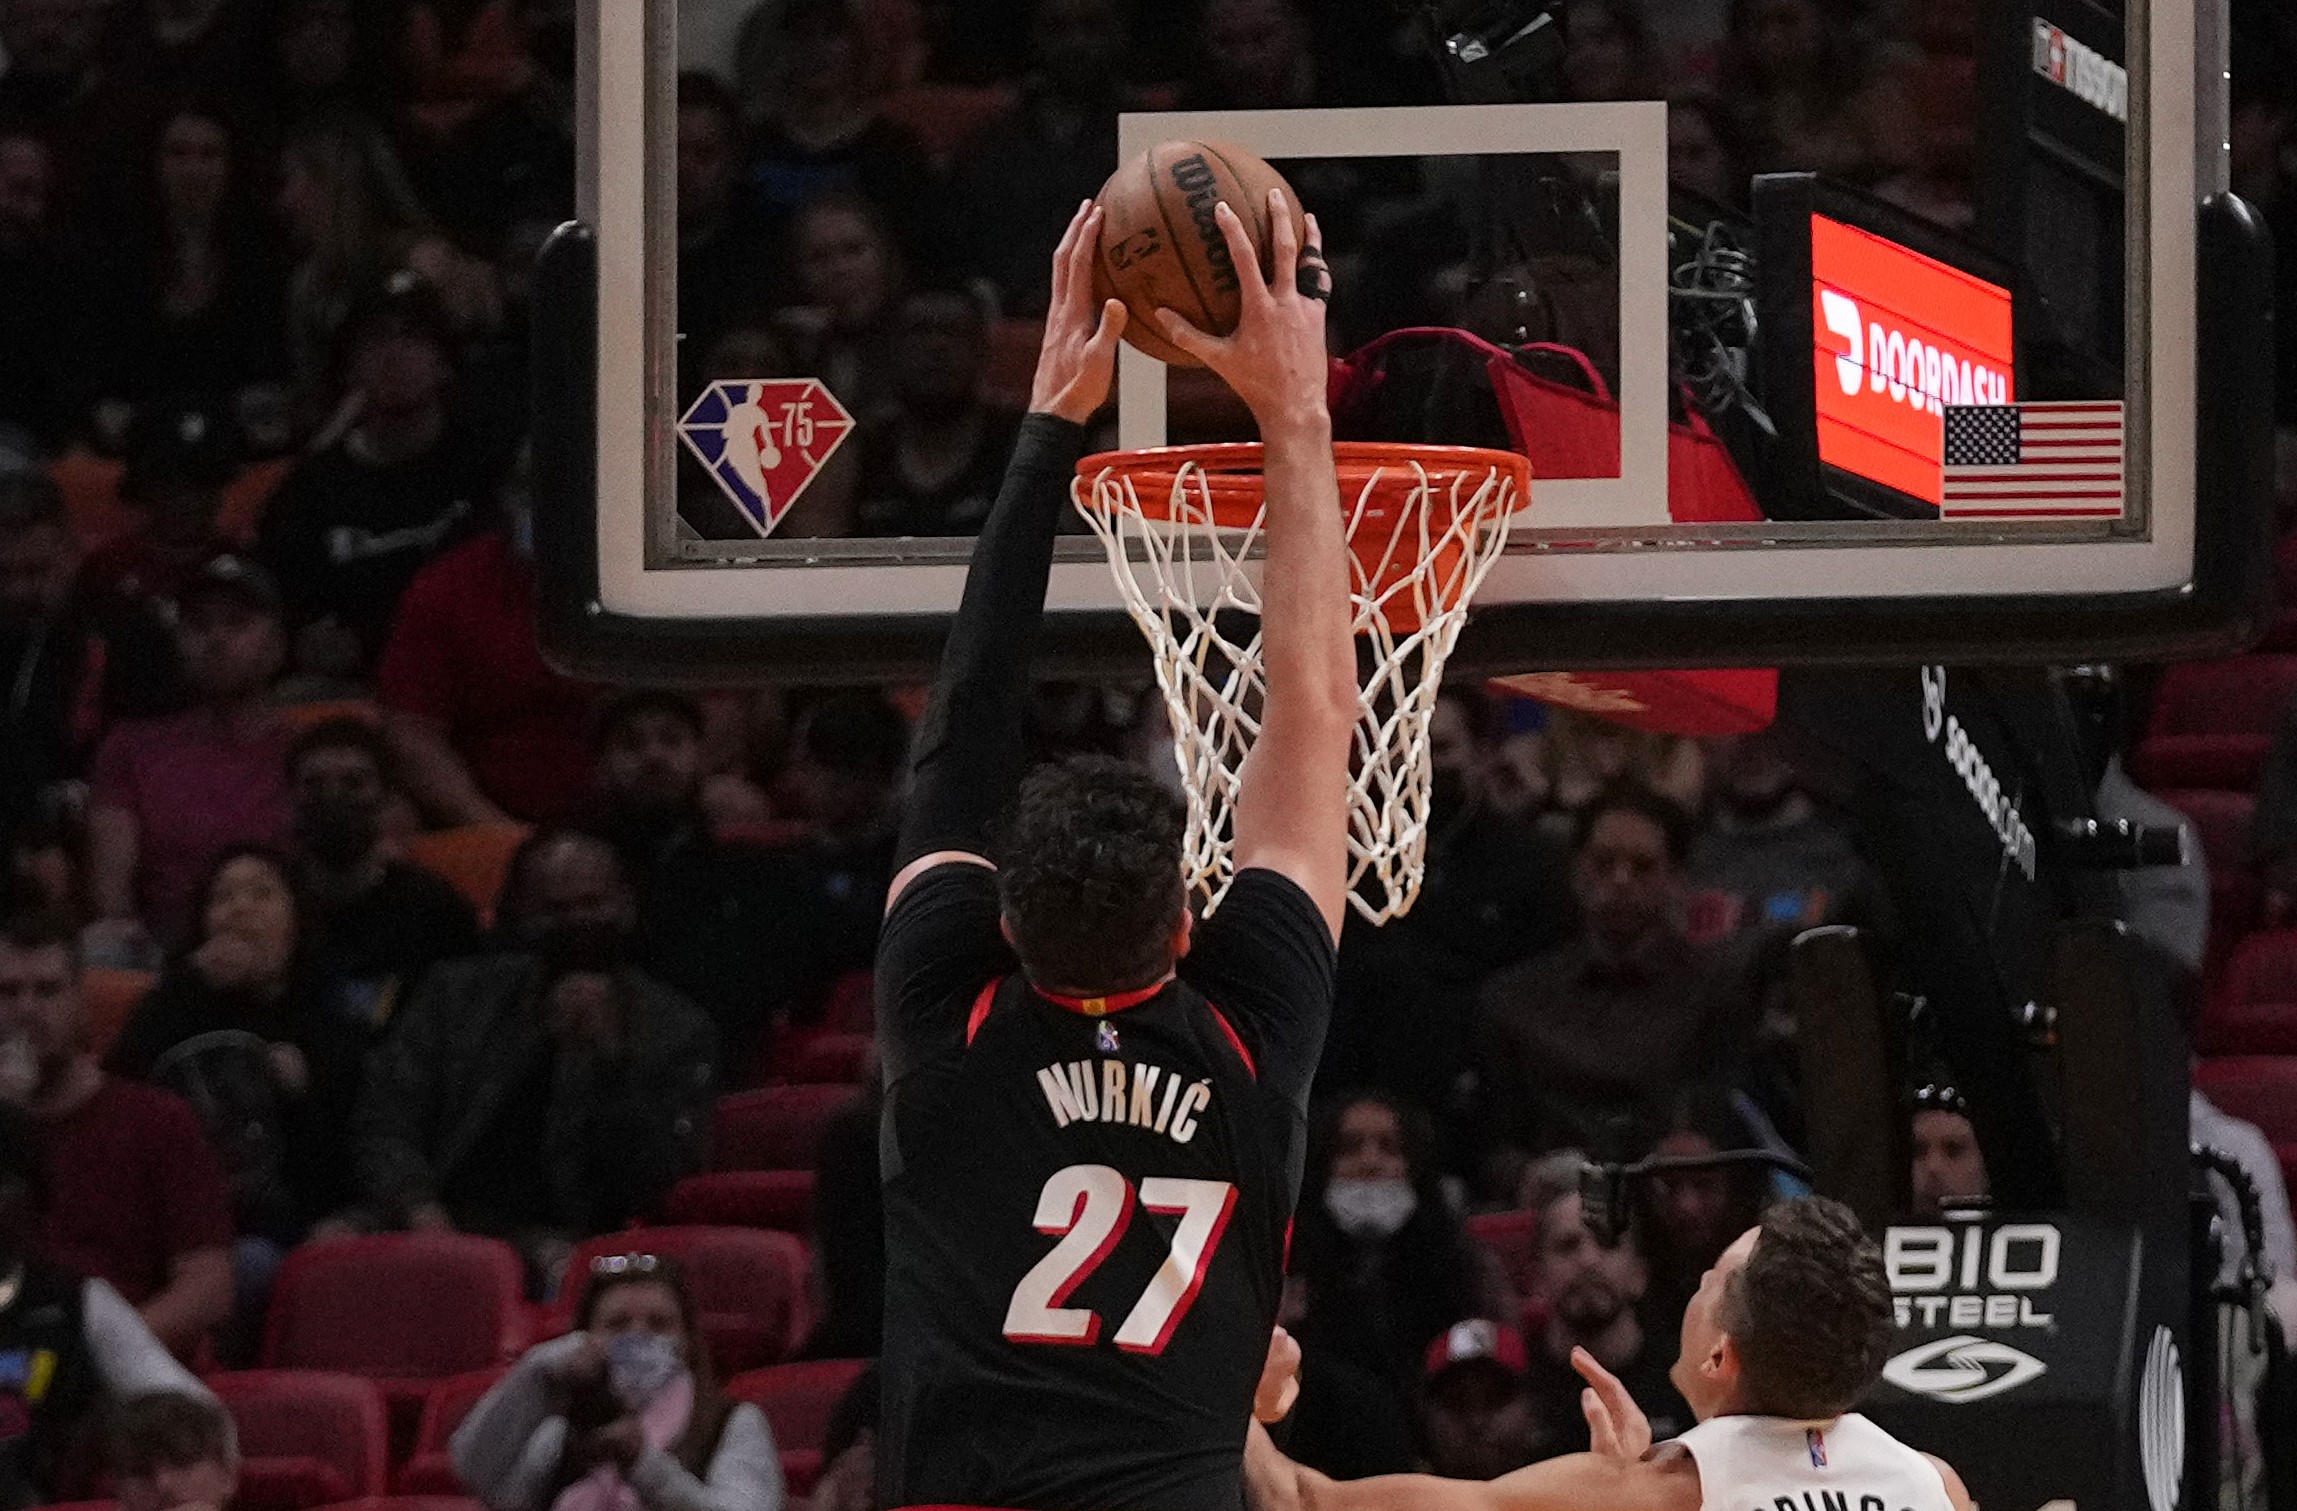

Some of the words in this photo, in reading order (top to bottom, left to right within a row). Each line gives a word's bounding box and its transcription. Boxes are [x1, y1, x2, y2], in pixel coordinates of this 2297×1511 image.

[1869, 322, 2007, 418] DOORDASH
[779, 402, 815, 447] 75
[1036, 1058, 1211, 1144] NURKIĆ
[1002, 1164, 1239, 1355] 27
[1884, 1223, 2062, 1292] BIO
